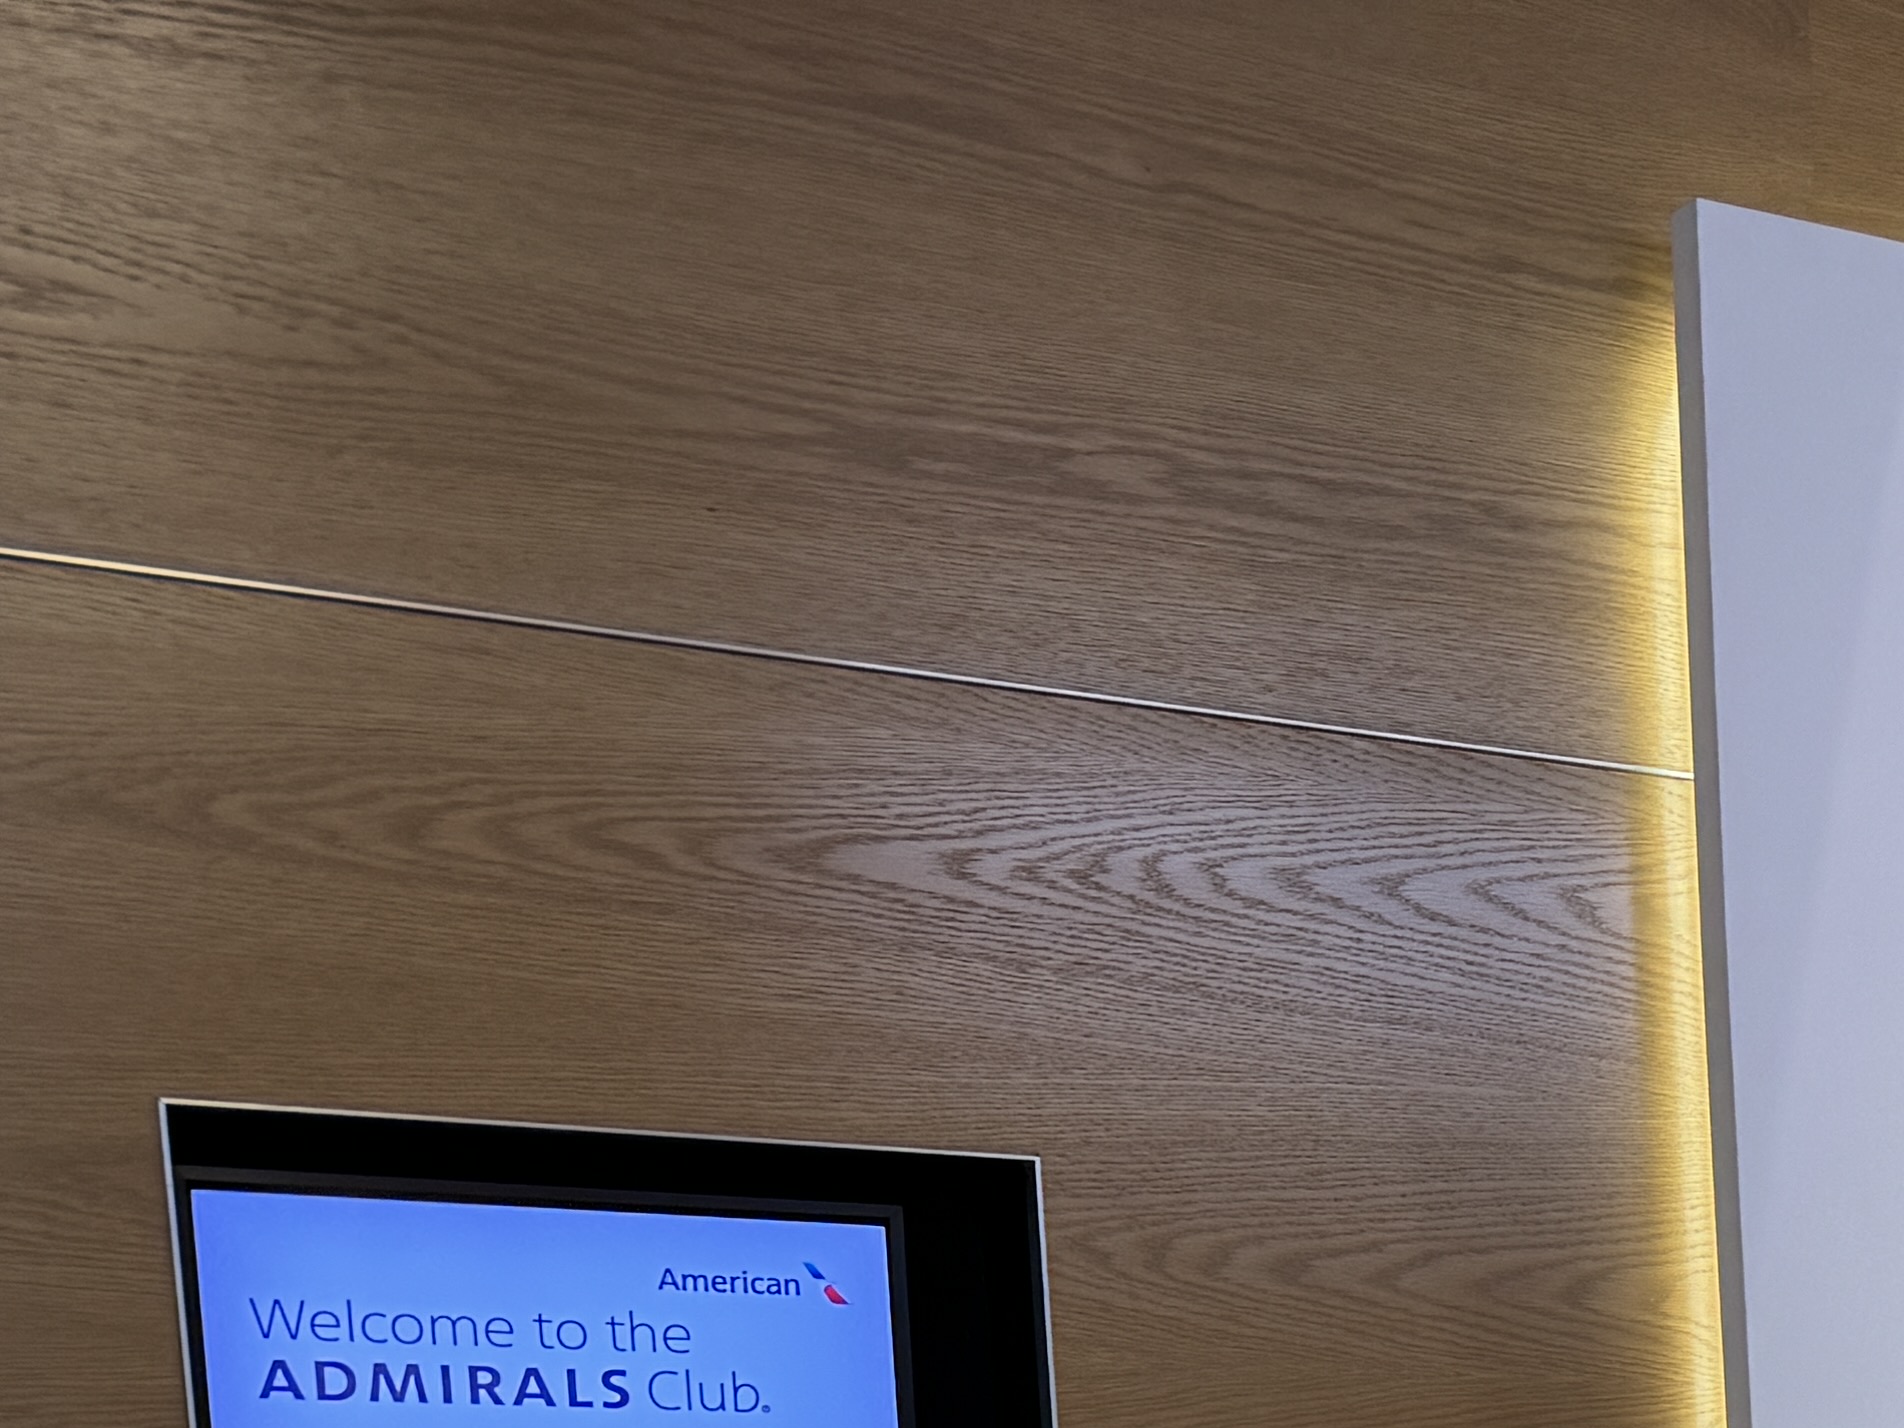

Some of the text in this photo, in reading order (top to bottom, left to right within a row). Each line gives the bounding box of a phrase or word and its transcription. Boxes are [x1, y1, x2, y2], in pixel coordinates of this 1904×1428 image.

[658, 1267, 801, 1297] American
[248, 1297, 691, 1354] Welcome to the
[258, 1359, 630, 1409] ADMIRALS
